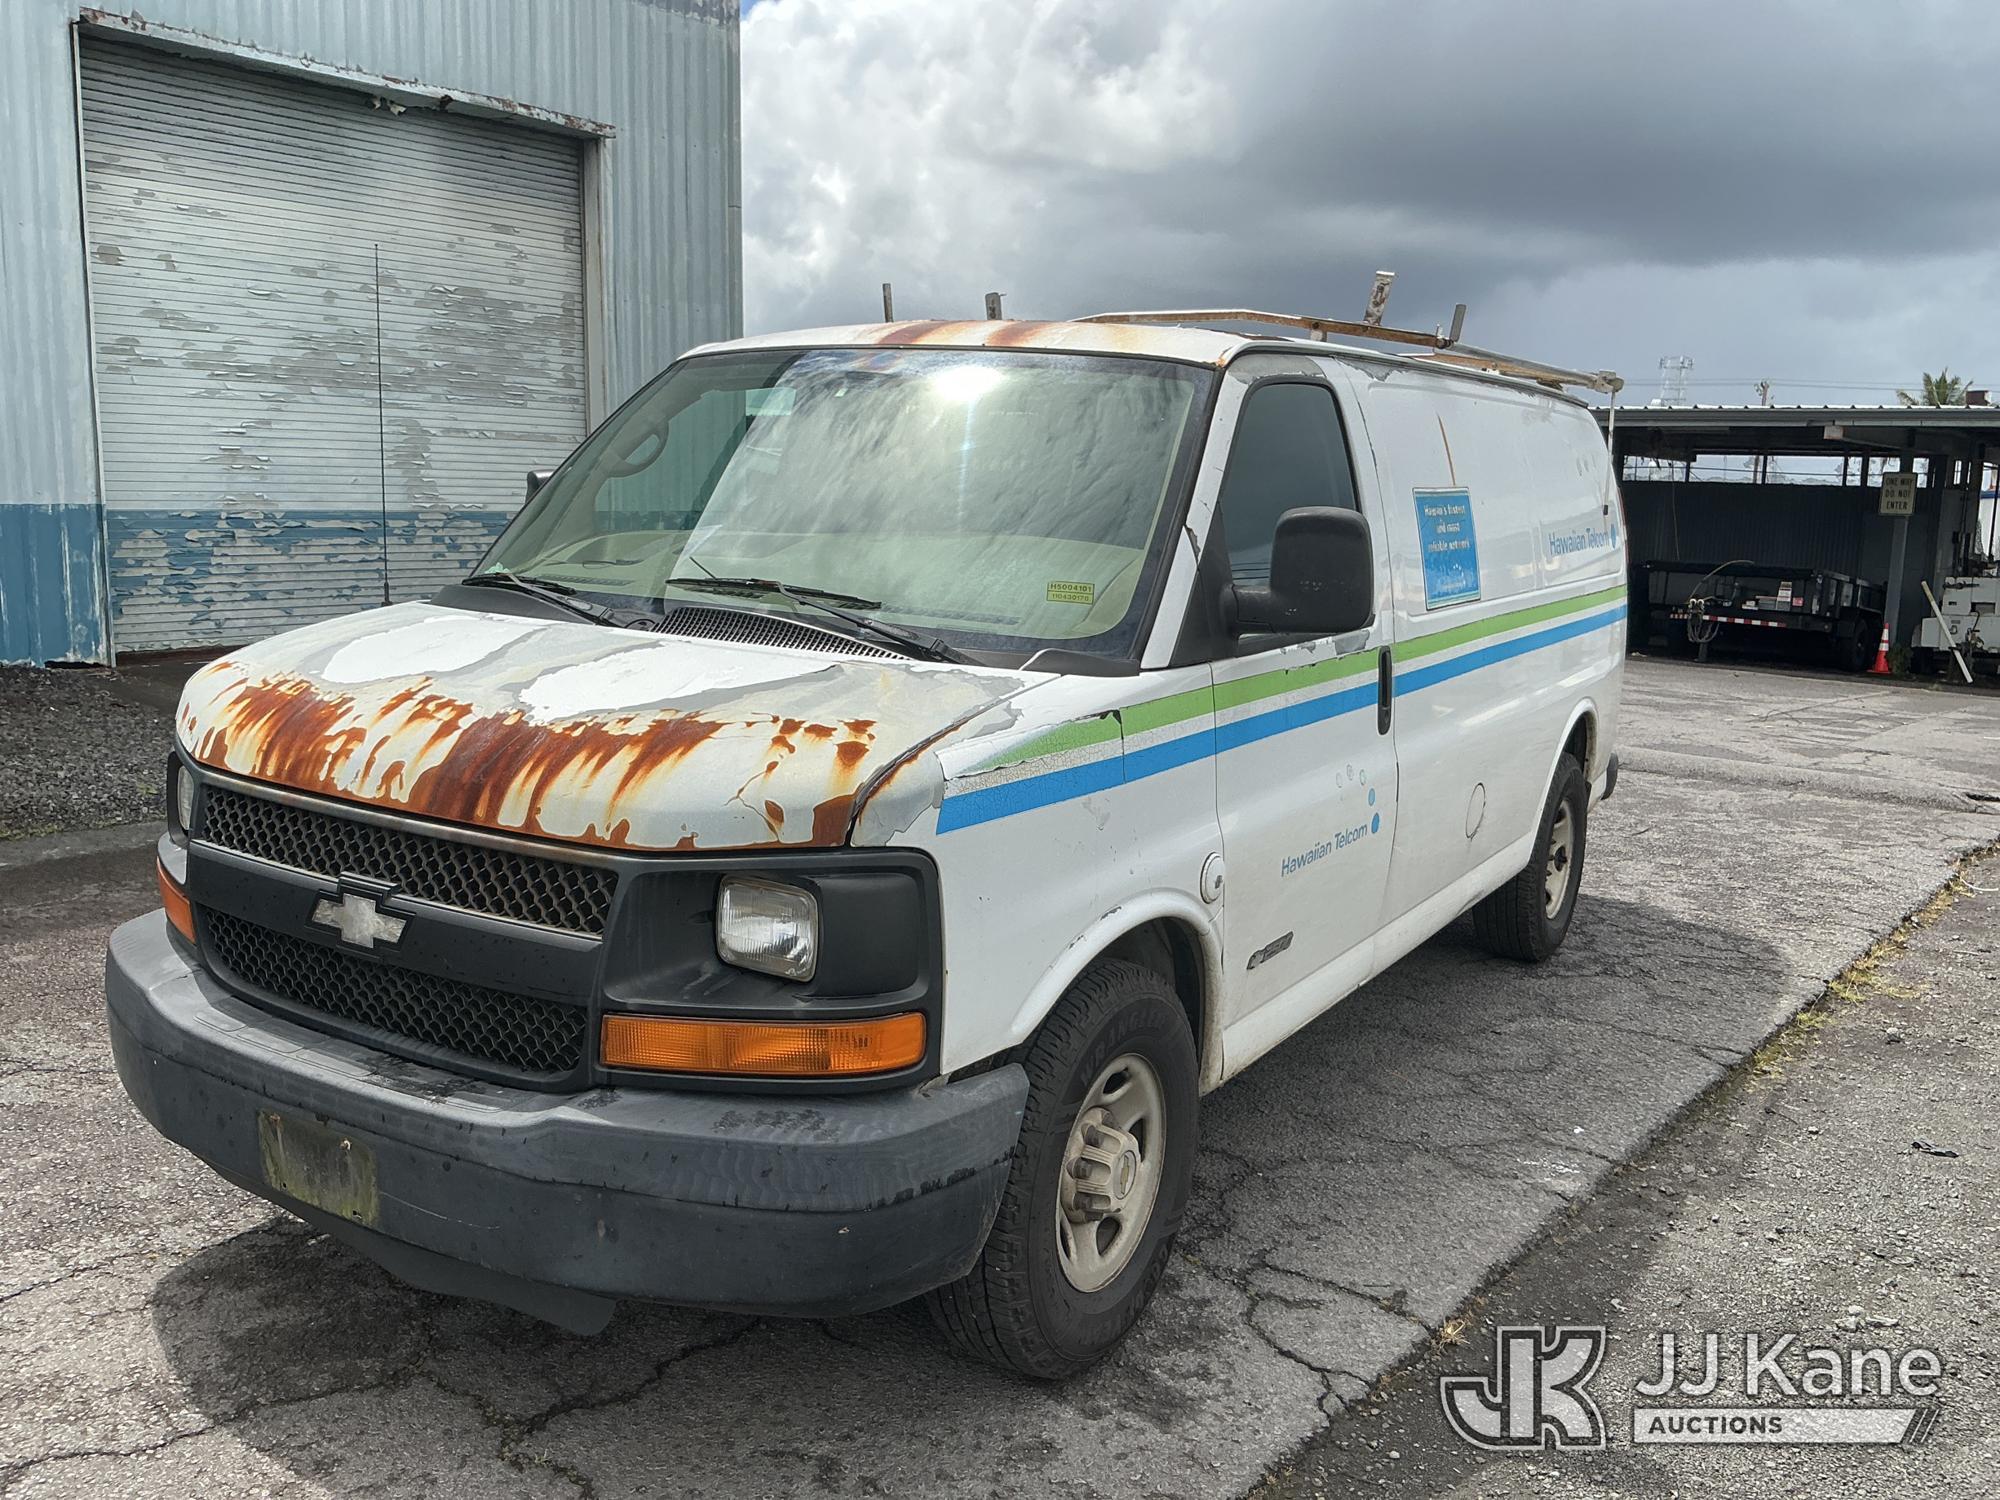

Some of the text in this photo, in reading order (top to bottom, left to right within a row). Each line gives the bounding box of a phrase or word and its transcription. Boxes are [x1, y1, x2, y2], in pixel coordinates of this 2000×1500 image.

[1885, 489, 1895, 498] DO
[1886, 500, 1908, 510] ENTER
[1548, 528, 1609, 555] Hawaiian Telcom
[1281, 824, 1368, 877] Hawaiian Telcom
